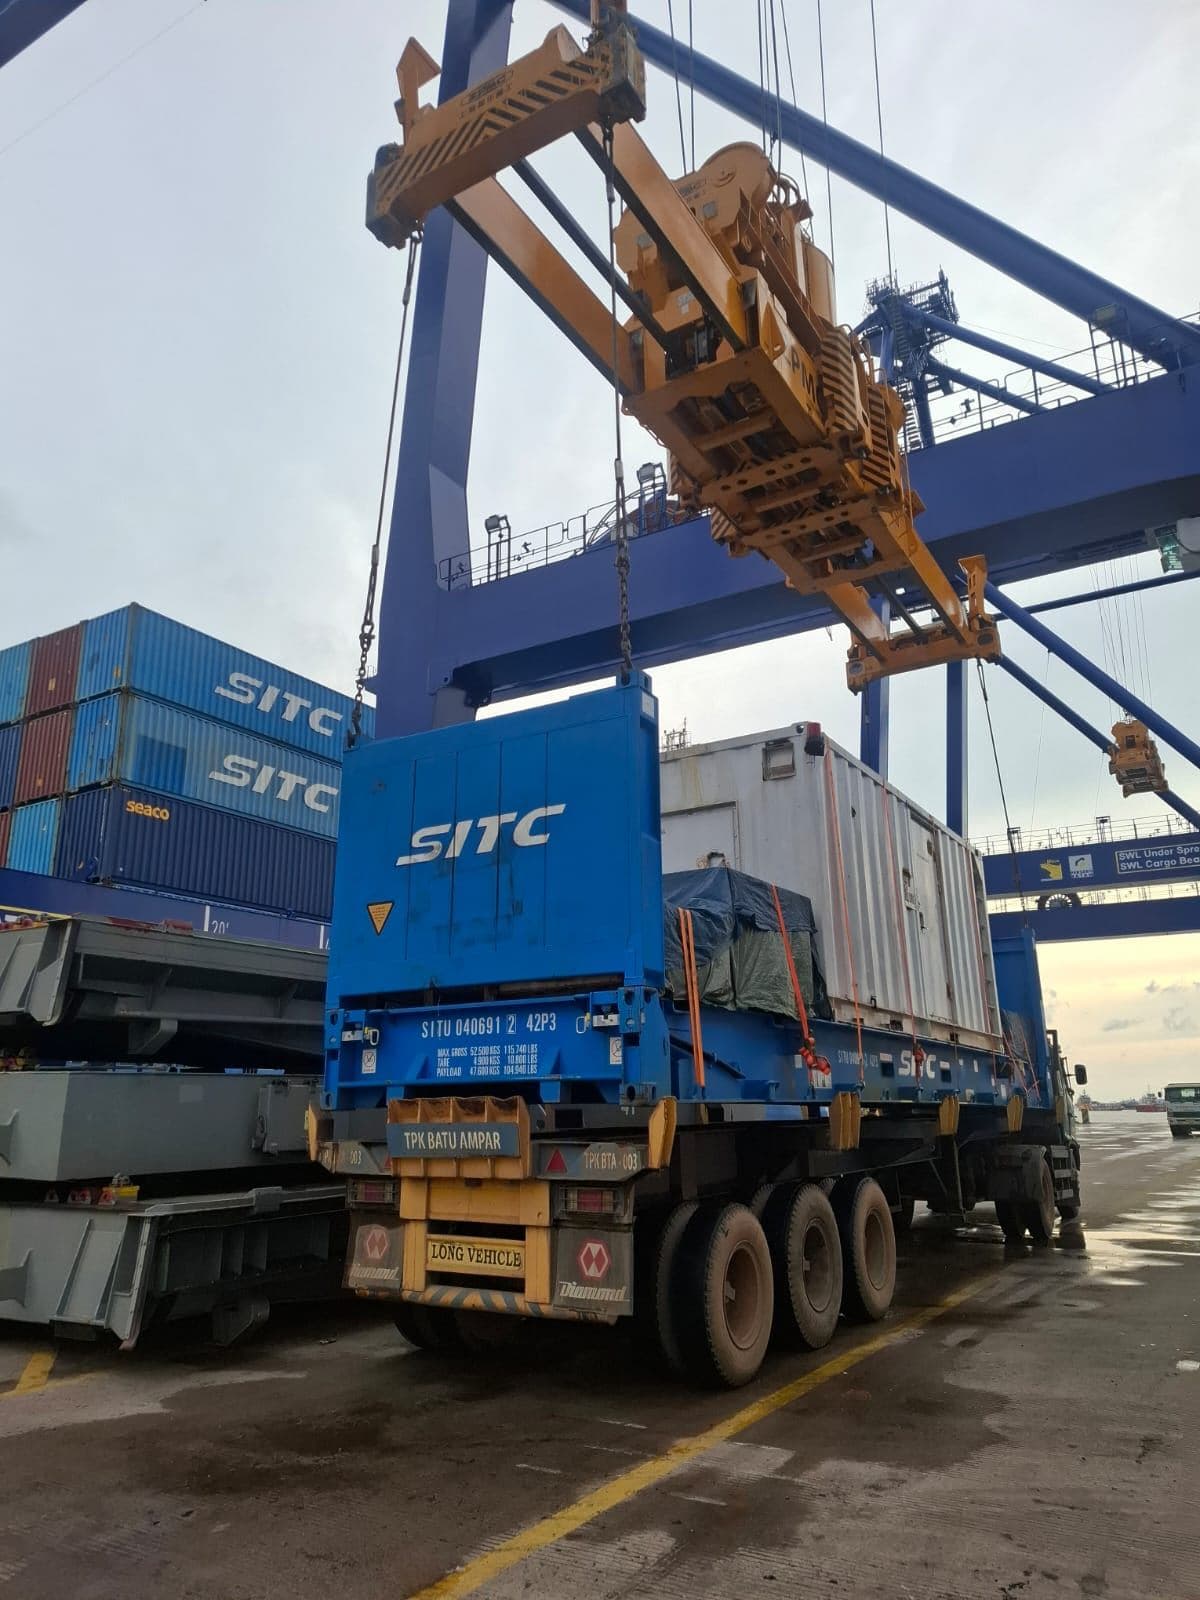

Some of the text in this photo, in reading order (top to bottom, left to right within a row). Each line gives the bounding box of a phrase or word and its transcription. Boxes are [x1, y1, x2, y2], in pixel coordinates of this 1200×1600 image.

[214, 672, 343, 737] SITC
[209, 754, 338, 813] SITC
[126, 799, 170, 822] seaco
[396, 803, 567, 866] SITC
[1119, 851, 1141, 861] SWL
[1144, 848, 1173, 857] Under
[1120, 861, 1143, 870] SWL
[1145, 859, 1177, 869] Cargo
[421, 1012, 557, 1039] SITU 040691 2 42P3
[437, 1048, 449, 1057] MAX
[451, 1047, 467, 1057] GROSS
[436, 1066, 462, 1077] PAYLOAD
[437, 1057, 450, 1067] TARE
[404, 1131, 501, 1150] TPK BATU AMPAR
[584, 1152, 600, 1169] TPK
[601, 1153, 617, 1169] BTA
[623, 1153, 638, 1170] 003
[431, 1244, 521, 1267] LONG VEHICLE
